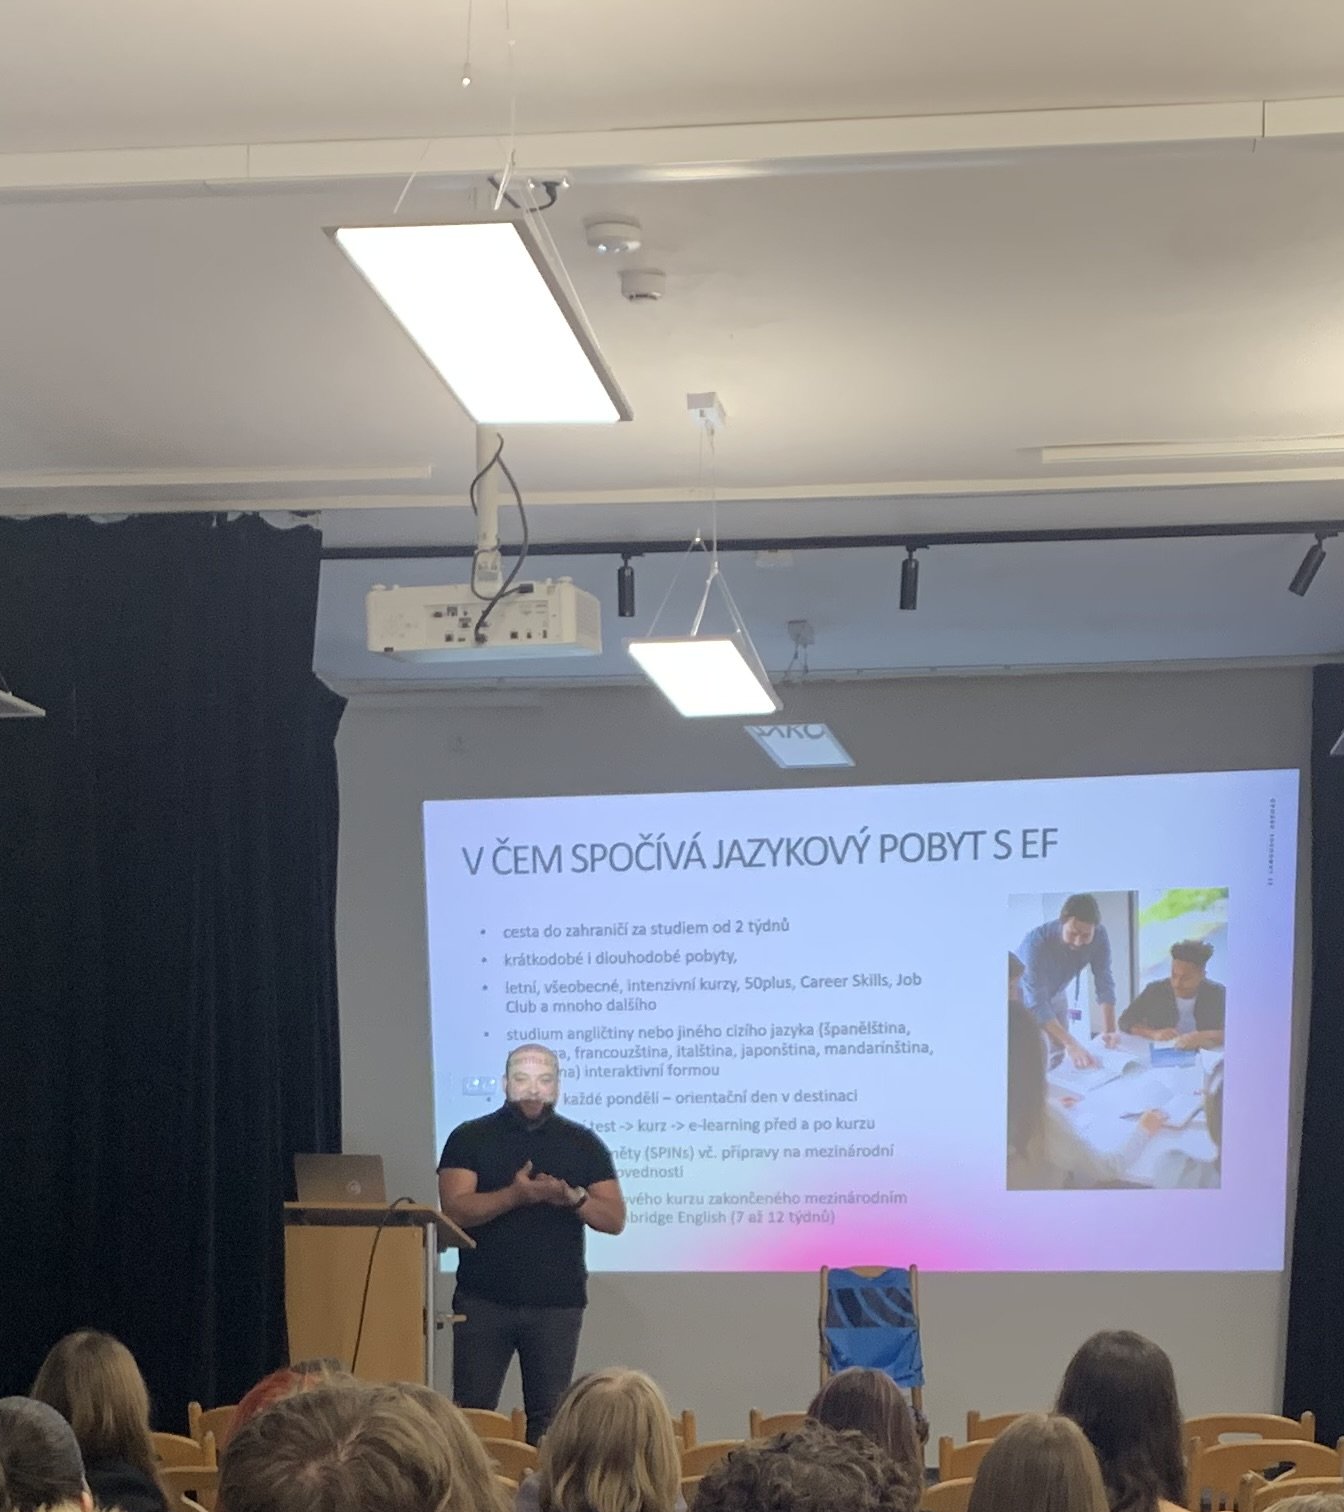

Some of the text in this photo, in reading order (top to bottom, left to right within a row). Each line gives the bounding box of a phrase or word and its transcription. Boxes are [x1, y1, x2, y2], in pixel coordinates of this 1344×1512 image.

[461, 825, 1059, 875] V ČEM SPOČÍVÁ JAZYKOVÝ POBYT S EF
[503, 917, 790, 939] cesta do zahraničí za studiem od 2 týdnů
[504, 949, 738, 967] krátkodobé i dlouhodobé pobyty,
[505, 972, 922, 996] letní, všeobecné, intenzivní kurzy, 50plus, Career Skills, Job
[506, 997, 657, 1014] Club a mnoho dalšího
[506, 1026, 564, 1041] studium
[567, 1025, 635, 1043] angličtiny
[638, 1024, 674, 1039] nebo
[676, 1024, 722, 1041] jiného
[726, 1024, 767, 1038] cizího
[769, 1023, 814, 1040] jazyka
[740, 1042, 820, 1060] japonština,
[584, 1062, 664, 1079] interaktivní
[667, 1062, 720, 1077] formou
[563, 1090, 603, 1106] každé
[675, 1089, 748, 1105] orientační
[751, 1090, 778, 1104] den
[781, 1093, 790, 1103] v
[638, 1119, 667, 1133] kurz
[688, 1118, 761, 1134] e-learning
[764, 1116, 797, 1133] před
[801, 1120, 810, 1130] a
[813, 1119, 832, 1133] po
[835, 1116, 875, 1130] kurzu
[644, 1145, 695, 1162] (SPINs)
[783, 1148, 801, 1158] na
[666, 1192, 705, 1206] kurzu
[678, 1210, 727, 1225] English
[730, 1210, 745, 1226] (7
[769, 1211, 785, 1223] 12
[789, 1209, 836, 1226] týdnů)
